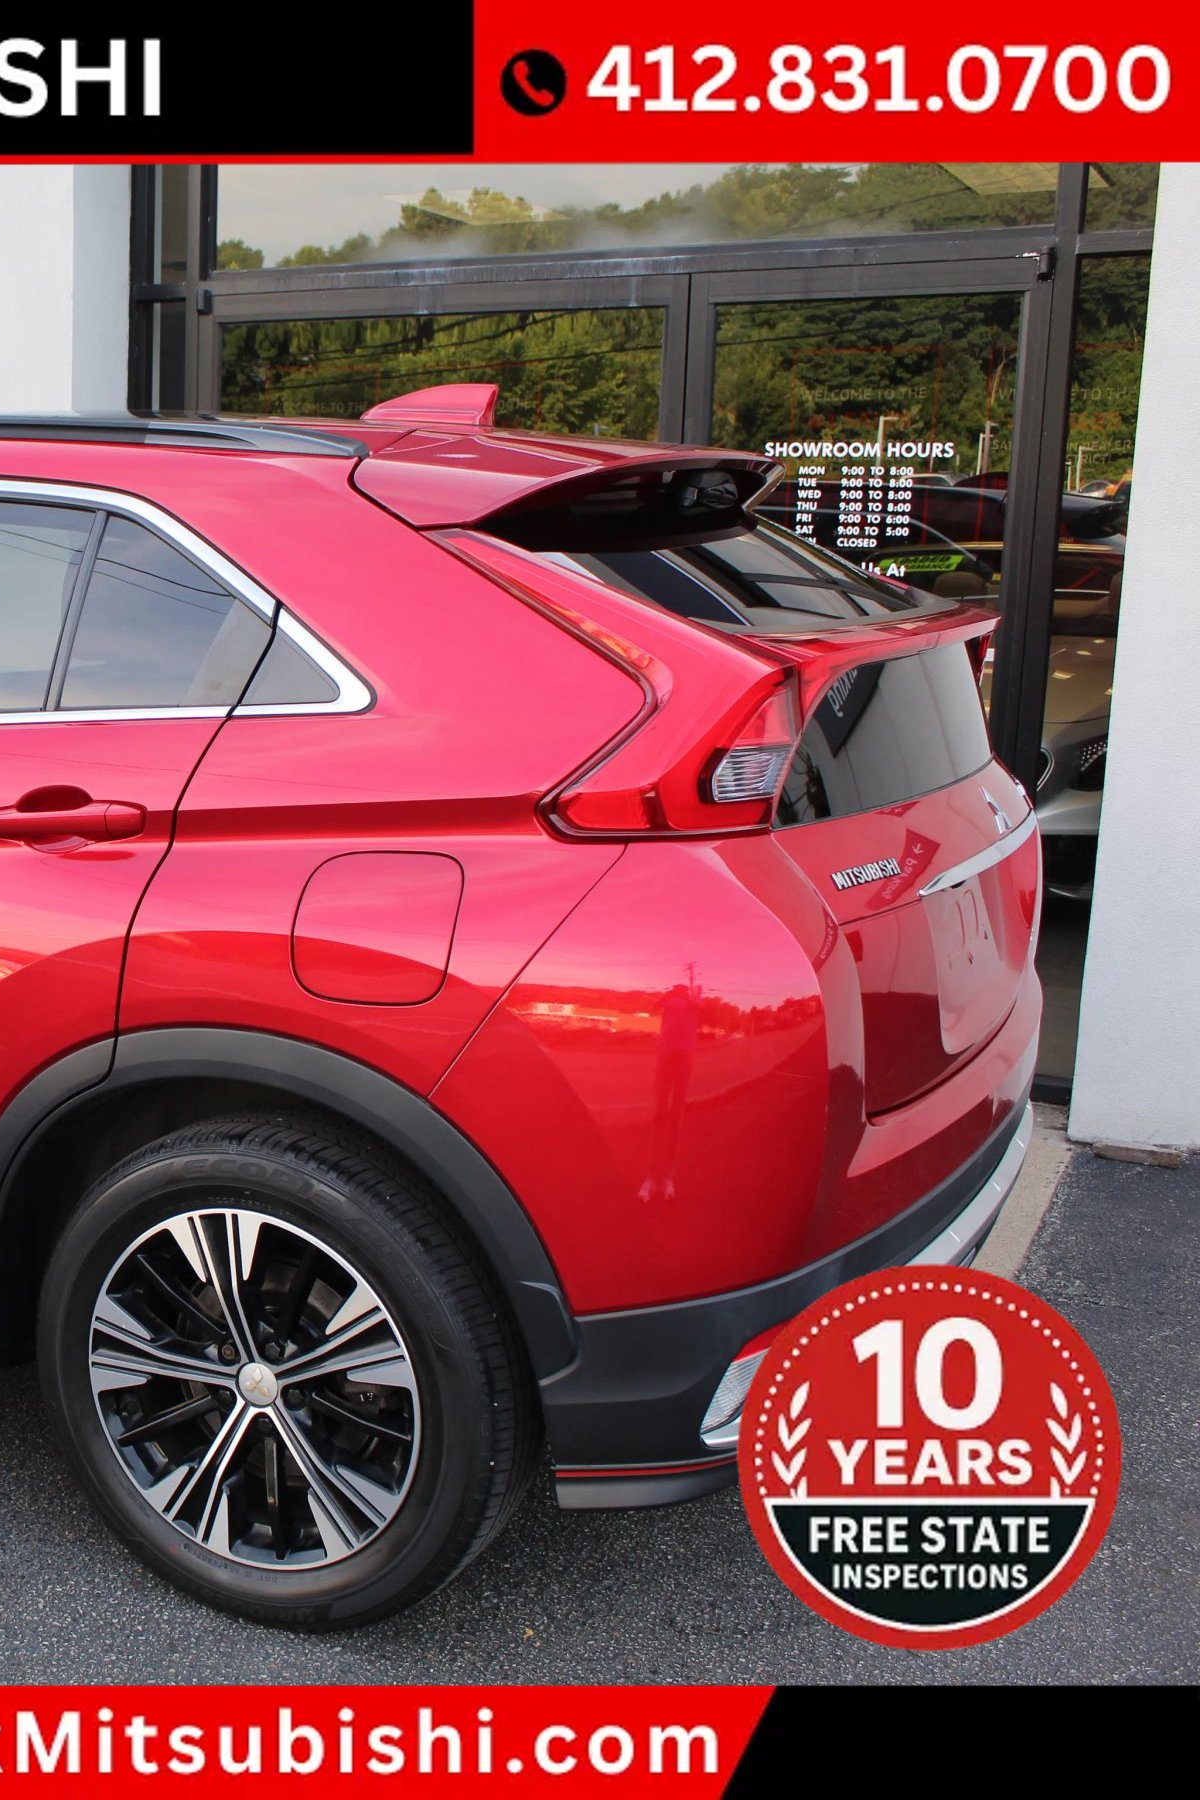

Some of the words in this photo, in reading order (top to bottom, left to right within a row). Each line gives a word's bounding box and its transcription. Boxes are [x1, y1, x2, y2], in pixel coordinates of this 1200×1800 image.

[764, 441, 880, 458] SHOWROOM
[887, 442, 954, 459] HOURS
[798, 466, 825, 475] MON
[841, 466, 865, 476] 9:00
[870, 466, 885, 476] TO
[889, 466, 914, 476] 8:00
[798, 478, 817, 487] TUE
[841, 478, 863, 488] 9:00
[869, 478, 883, 487] TO
[889, 478, 913, 488] 8:00
[797, 490, 821, 499] WED
[840, 490, 863, 499] 9:00
[868, 490, 883, 500] TO
[887, 491, 912, 500] 8:00
[796, 501, 817, 511] THU
[839, 502, 862, 512] 9:00
[867, 502, 882, 512] TO
[887, 503, 911, 512] 8:00
[796, 513, 812, 522] FRI
[838, 514, 861, 523] 9:00
[866, 514, 881, 524] TO
[885, 515, 910, 524] 6:00
[795, 525, 814, 534] SAT
[837, 526, 860, 536] 9:00
[864, 526, 879, 536] TO
[885, 527, 909, 536] 5:00
[836, 538, 877, 548] CLOSED
[886, 562, 906, 577] At
[832, 857, 901, 891] MITSUBISHI
